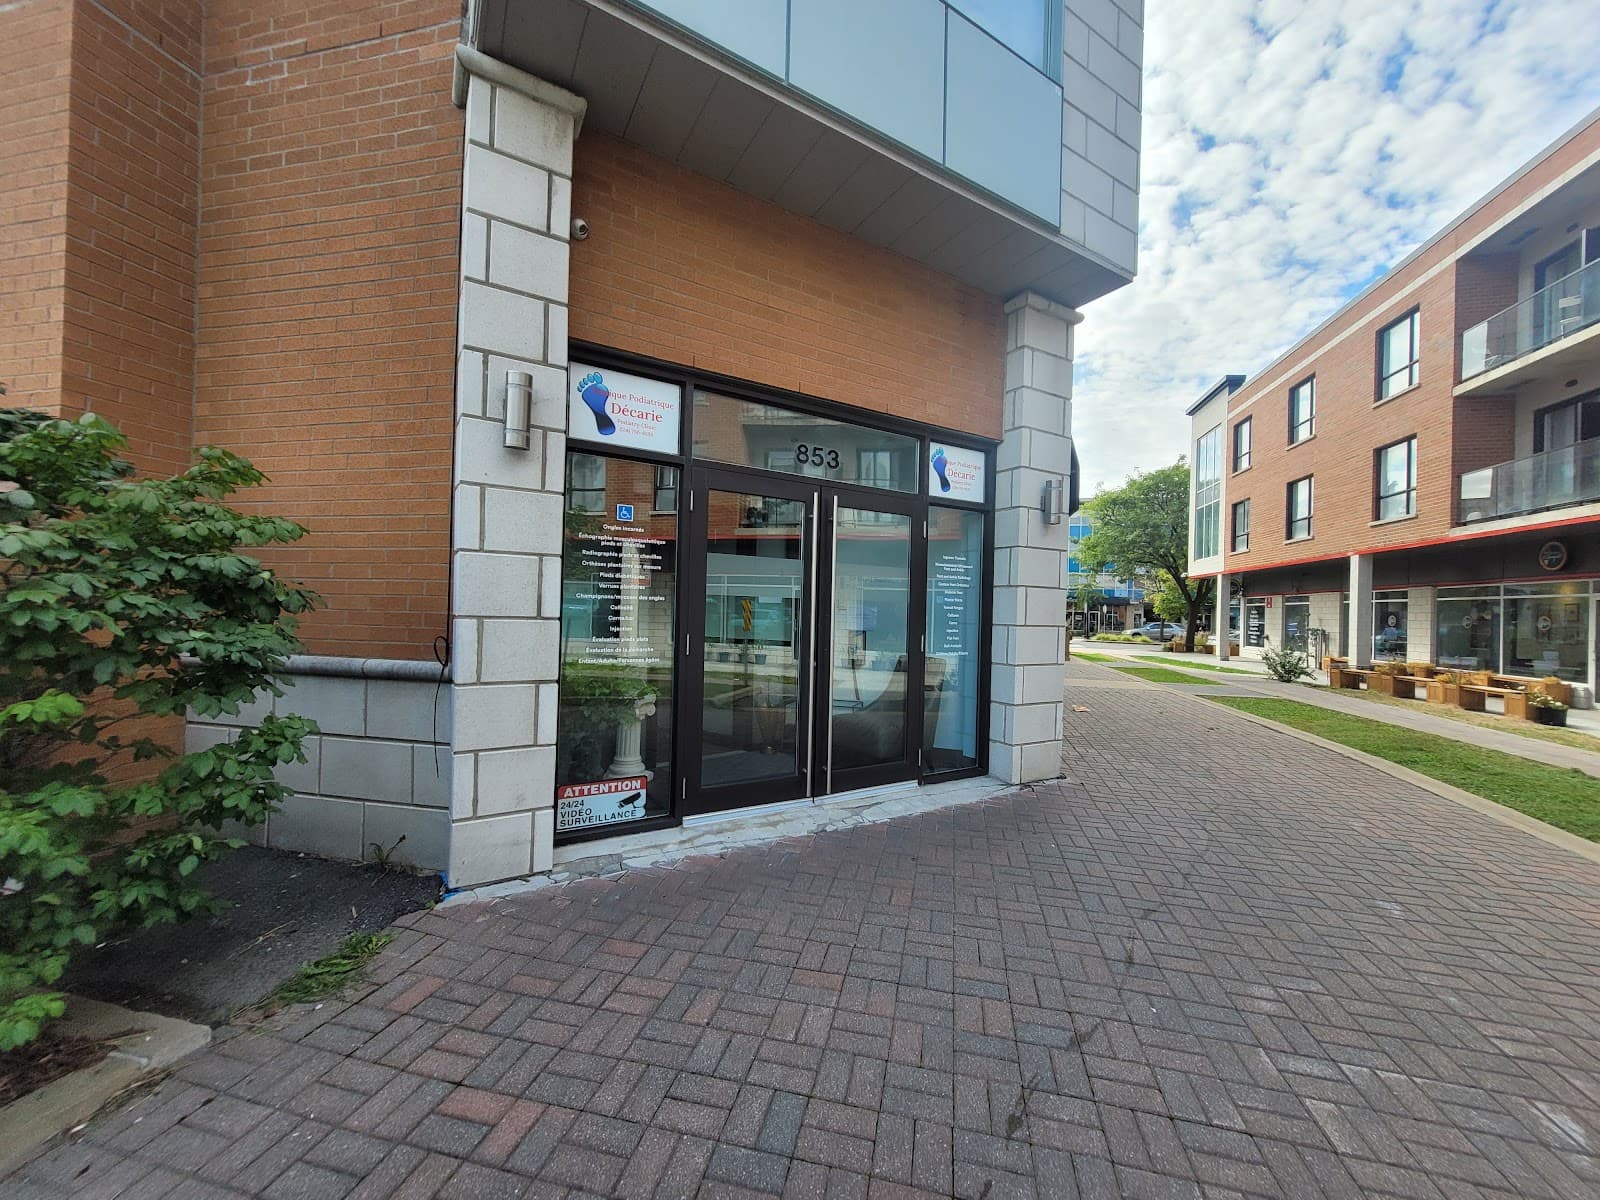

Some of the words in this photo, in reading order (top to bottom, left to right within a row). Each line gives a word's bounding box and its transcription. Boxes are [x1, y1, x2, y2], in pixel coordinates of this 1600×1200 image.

[629, 394, 674, 409] Podiatrique
[610, 402, 663, 422] Décarie
[797, 444, 840, 469] 853
[564, 780, 641, 798] ATTENTION
[560, 800, 585, 810] 24/24
[560, 810, 637, 828] SURVEILLANCE
